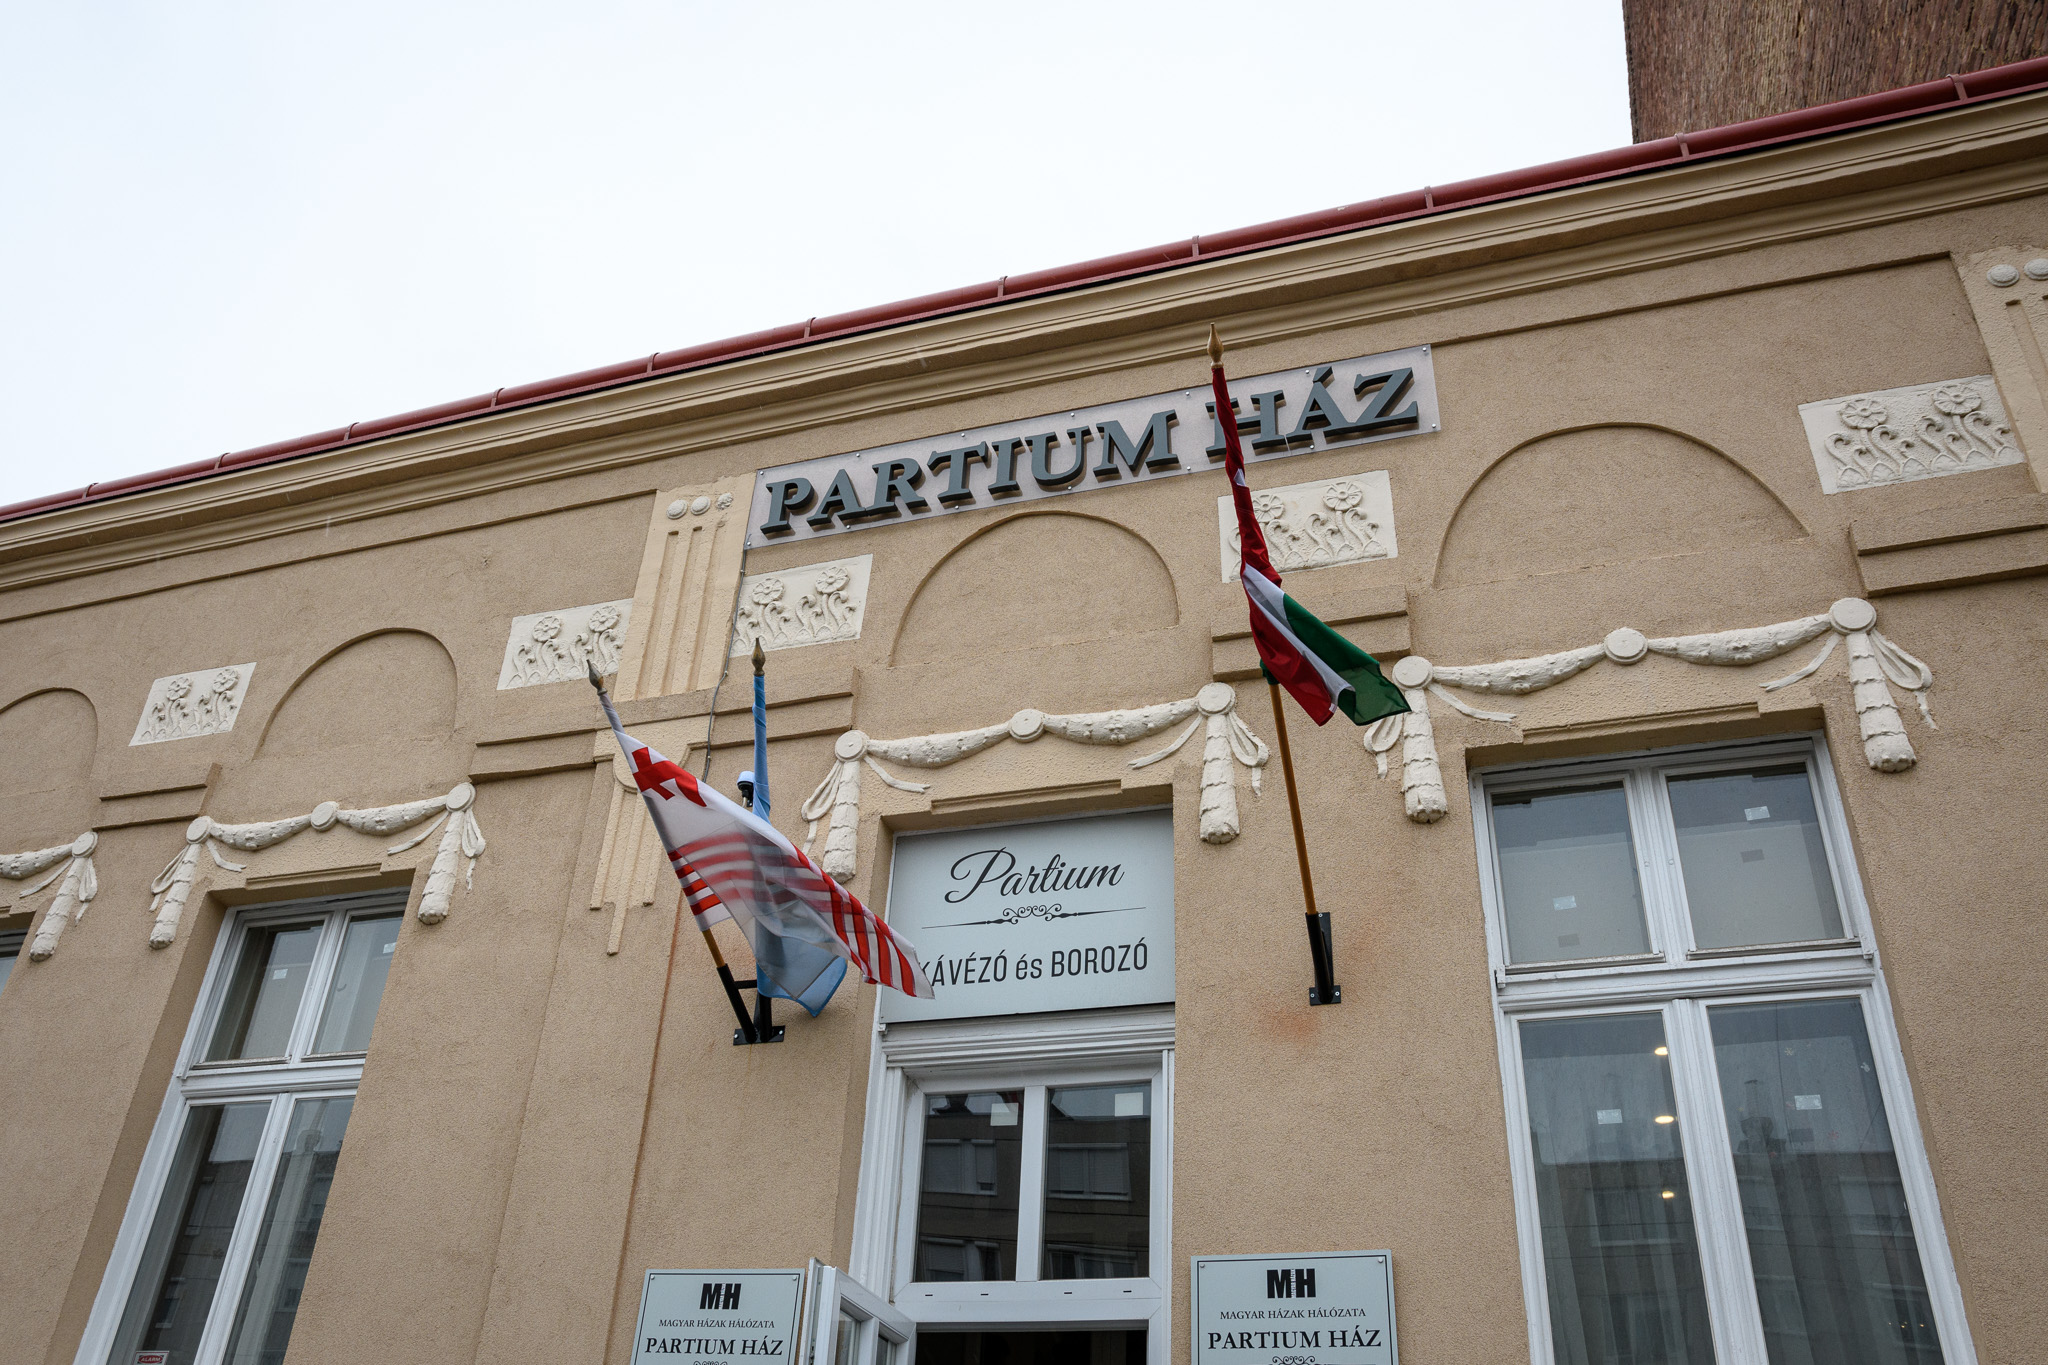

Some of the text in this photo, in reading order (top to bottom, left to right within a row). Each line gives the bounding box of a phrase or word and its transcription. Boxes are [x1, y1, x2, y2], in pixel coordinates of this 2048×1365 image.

[760, 366, 1420, 535] PARTIUM HÁZ
[944, 847, 1125, 903] Partium
[1015, 953, 1043, 980] és
[1051, 937, 1148, 978] BOROZÓ
[699, 1283, 742, 1310] MH
[1266, 1268, 1316, 1299] MH
[658, 1317, 775, 1329] MAGYAR HÁZAK HÁLÓZATA
[1220, 1307, 1367, 1320] MAGYAR HÁZAK HÁLÓZATA
[645, 1335, 783, 1355] PARTIUM HÁZ
[1207, 1325, 1382, 1350] PARTIUM HÁZ
